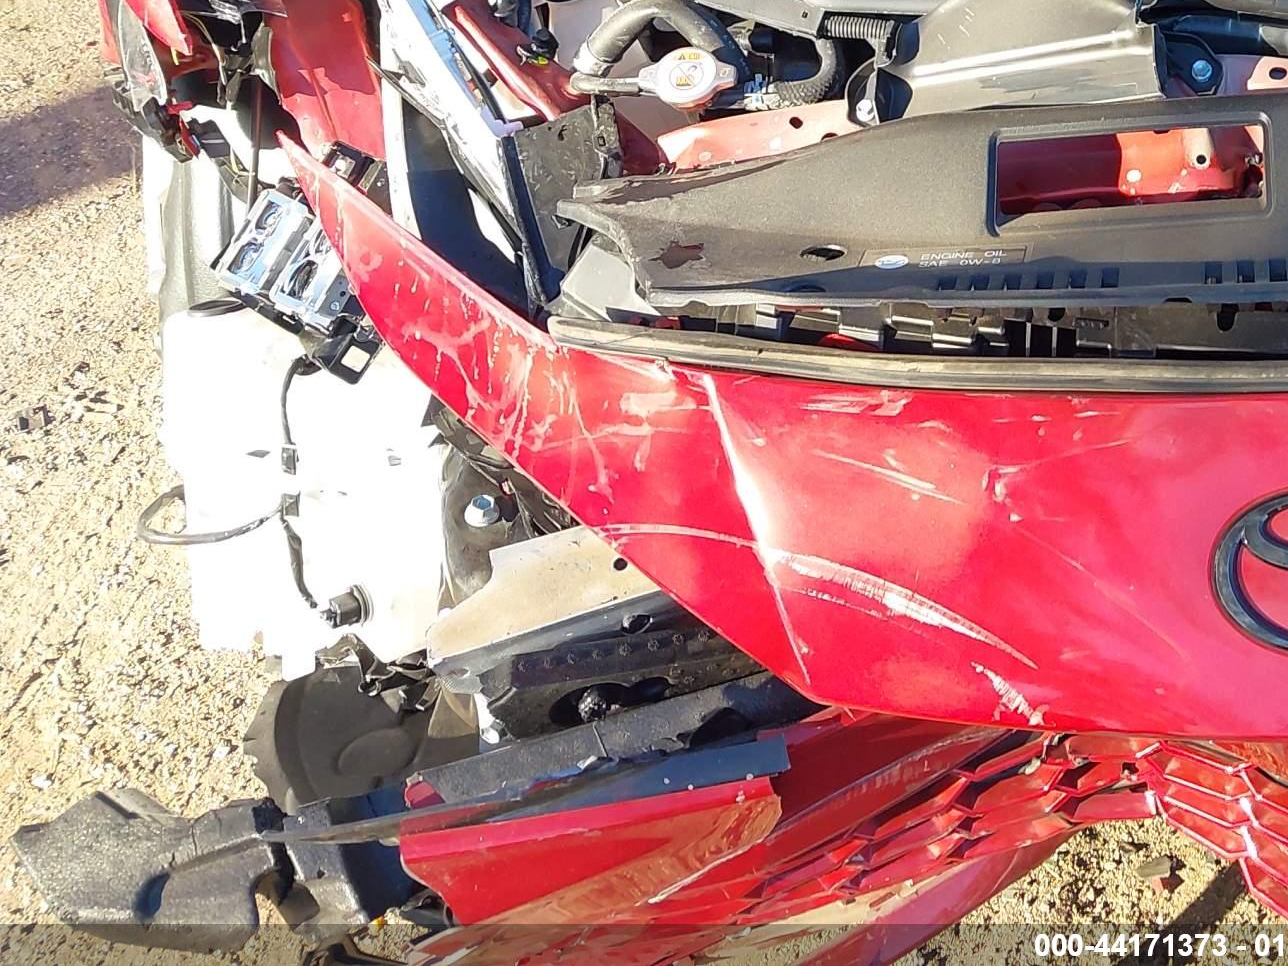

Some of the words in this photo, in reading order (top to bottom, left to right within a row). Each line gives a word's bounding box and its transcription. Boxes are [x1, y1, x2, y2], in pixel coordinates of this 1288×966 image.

[920, 251, 976, 260] ENGINE
[984, 249, 1007, 258] OIL
[919, 259, 949, 267] SAE
